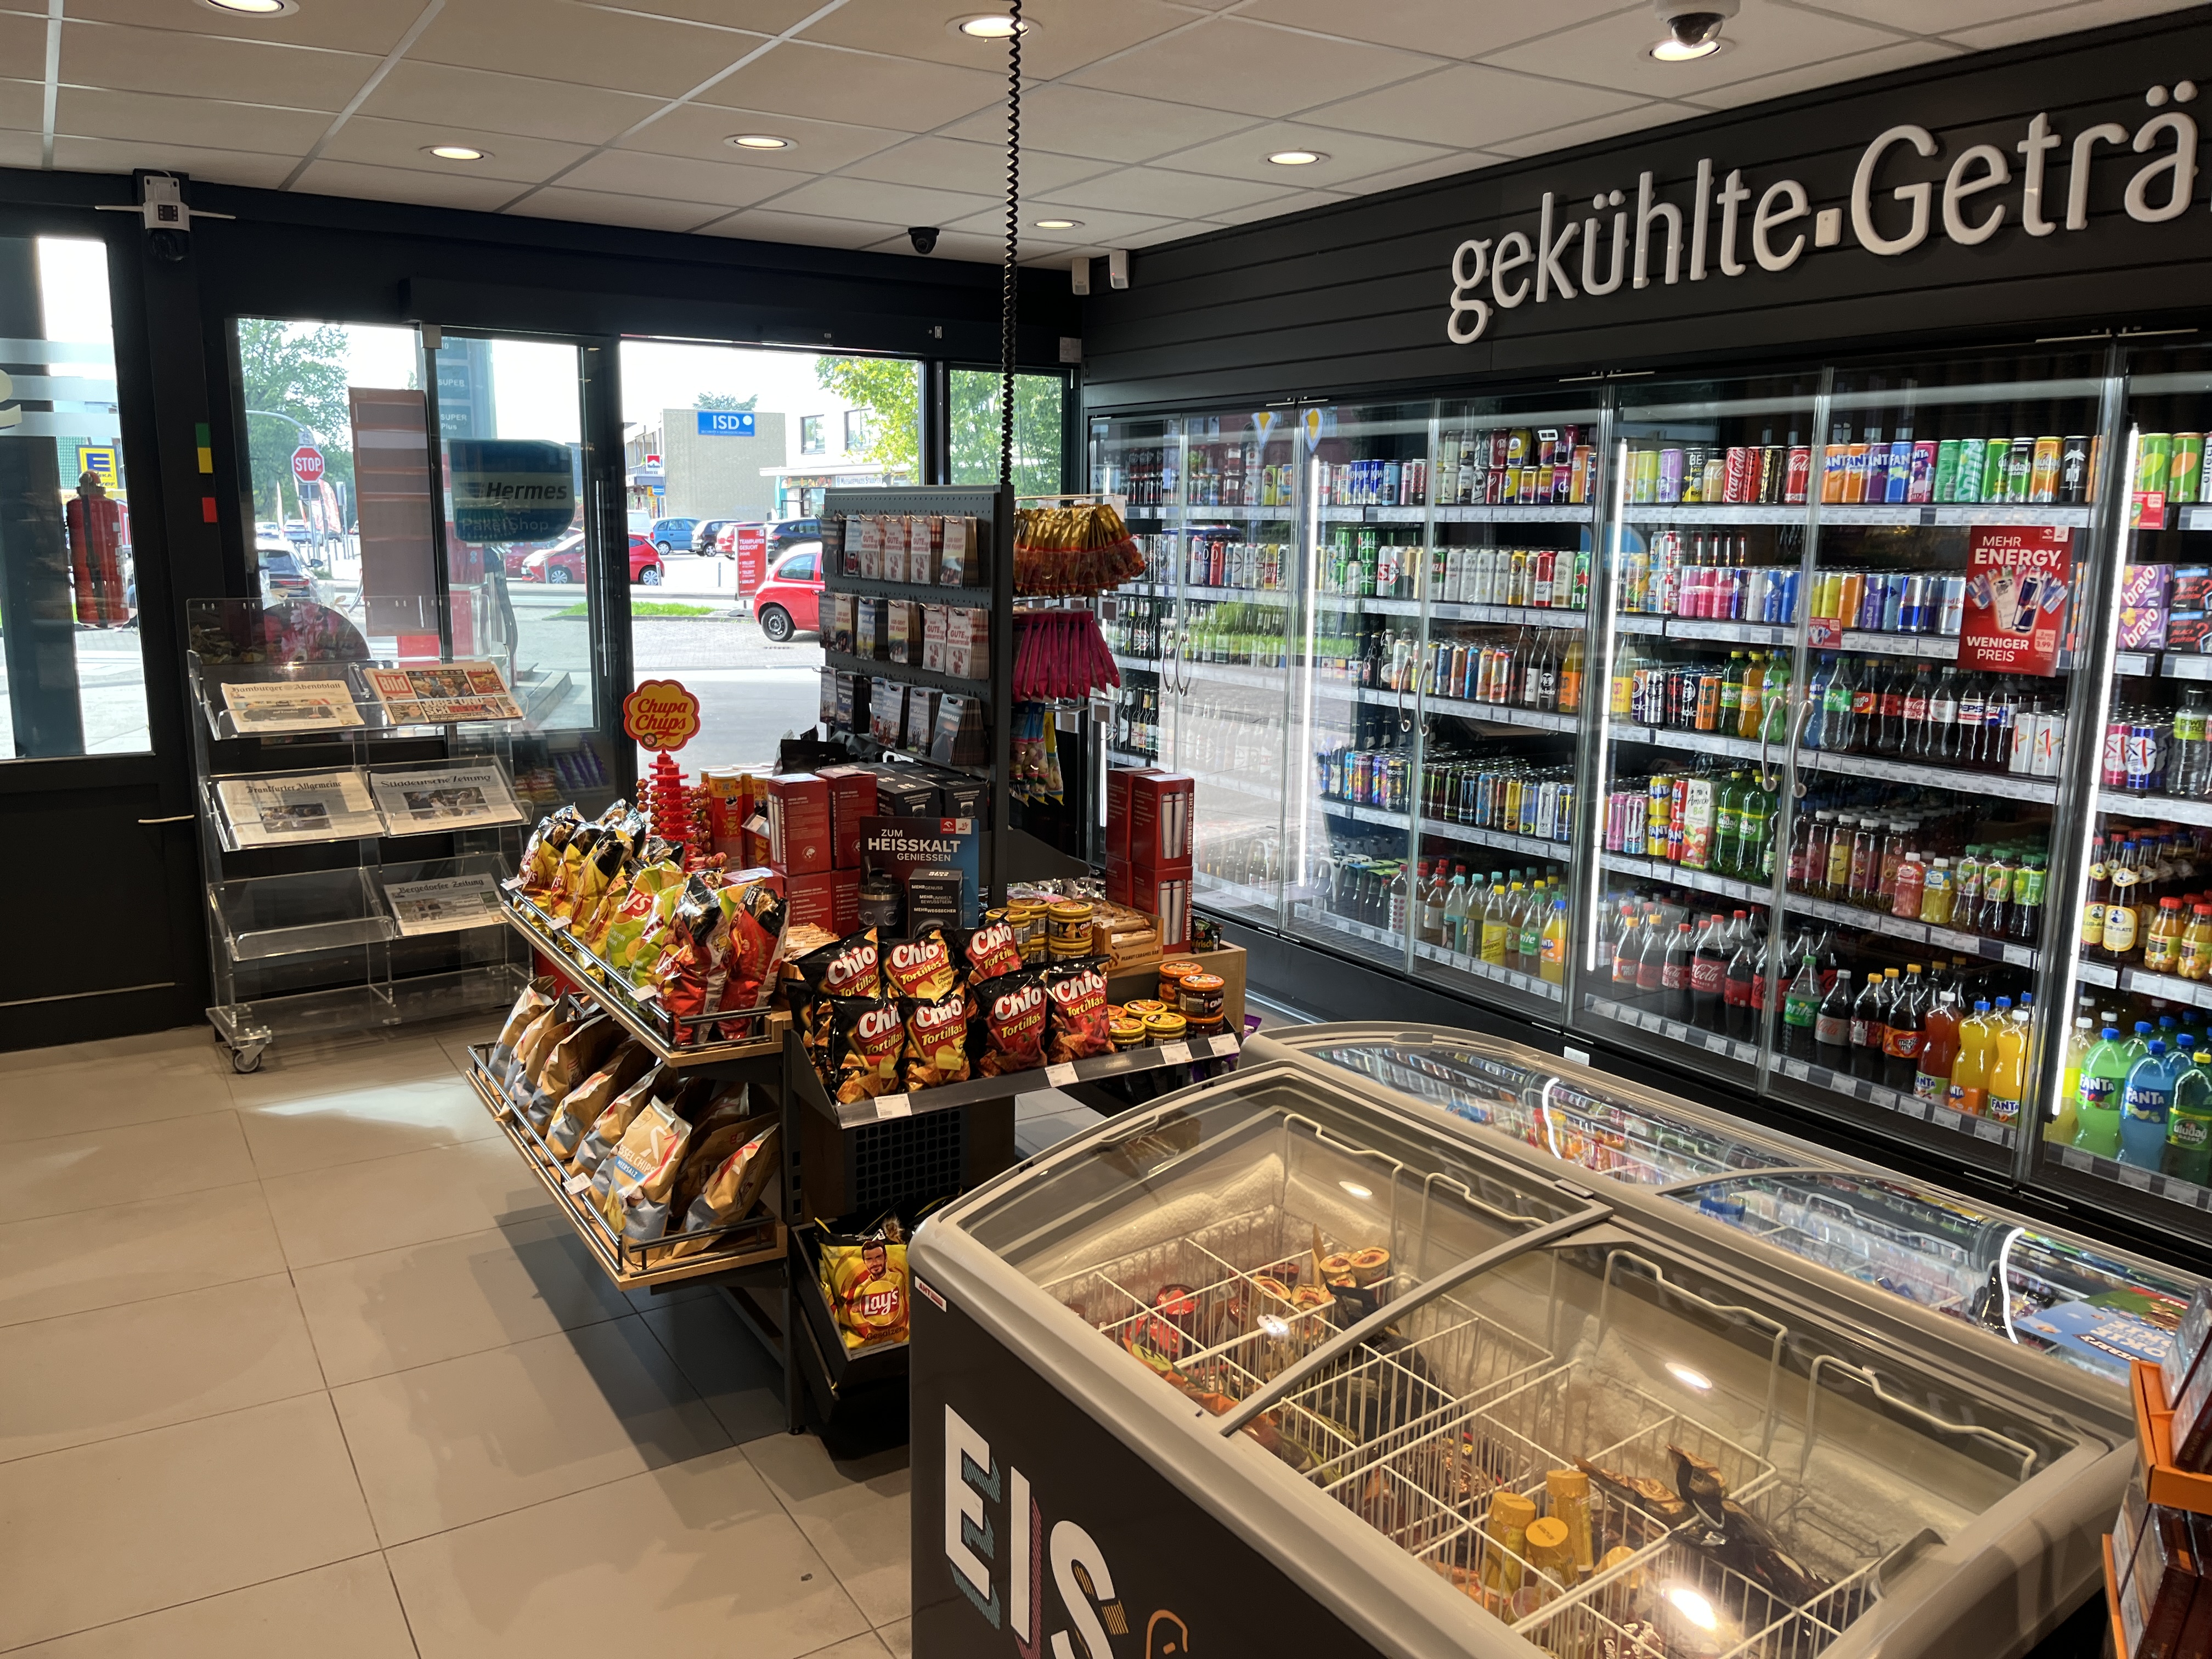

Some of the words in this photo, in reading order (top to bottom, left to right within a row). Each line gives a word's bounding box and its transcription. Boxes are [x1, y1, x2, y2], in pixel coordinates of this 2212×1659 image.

[1447, 158, 1812, 345] gekühlte
[1850, 80, 2212, 256] Geträ
[438, 379, 465, 387] SUPER
[713, 415, 740, 430] ISD
[295, 457, 321, 472] STOP
[486, 482, 567, 500] Hermes
[462, 517, 549, 532] PaketShop
[1983, 535, 2022, 547] MEHR
[1974, 548, 2062, 570] ENERGY,
[2122, 566, 2156, 606] bravo
[950, 630, 965, 639] GUTE
[2122, 608, 2159, 648] bravo
[1967, 636, 2029, 650] WENIGER
[1977, 648, 2015, 662] PREIS
[378, 676, 409, 692] Bild
[637, 698, 688, 717] Chupa
[1986, 706, 2001, 714] PSI
[635, 714, 686, 737] Chups
[246, 785, 295, 794] Frankfurter
[296, 781, 342, 791] Allgemeine
[381, 777, 450, 788] Süddeutsche
[450, 775, 491, 783] Zeitung
[1694, 806, 1704, 815] Bio
[881, 829, 903, 837] ZUM
[1649, 825, 1668, 835] FANT
[868, 838, 961, 853] HEISSKALT
[897, 853, 951, 862] GENIESSEN
[398, 883, 449, 894] Bergedorfer
[452, 879, 484, 888] Zeitung
[972, 923, 1012, 955] Chio
[892, 940, 940, 968] Chio
[827, 946, 877, 985] Chio
[900, 959, 943, 985] Tortillas
[839, 973, 876, 997] Tortillas
[1056, 969, 1104, 1003] Chio
[995, 986, 1042, 1021] Chio
[1066, 994, 1104, 1018] Tortillas
[1786, 1002, 1813, 1017] prite
[916, 998, 963, 1028] Chio
[922, 1023, 963, 1046] Tortillas
[1001, 1012, 1041, 1040] Tortillas
[865, 1030, 902, 1054] Tortillas
[1916, 1076, 1936, 1087] ANTA
[2080, 1074, 2115, 1091] FANTA
[1950, 1085, 1964, 1096] NTA
[2126, 1087, 2165, 1105] FANTA
[1991, 1098, 2020, 1111] FANTA
[618, 1144, 634, 1164] ESSEL
[633, 1155, 657, 1173] CHIPS
[617, 1159, 638, 1178] MEERSALZ
[919, 1283, 933, 1299] AHT
[864, 1288, 899, 1316] Lay's
[866, 1325, 905, 1341] Gesalzen
[945, 1403, 1117, 1659] EIS
